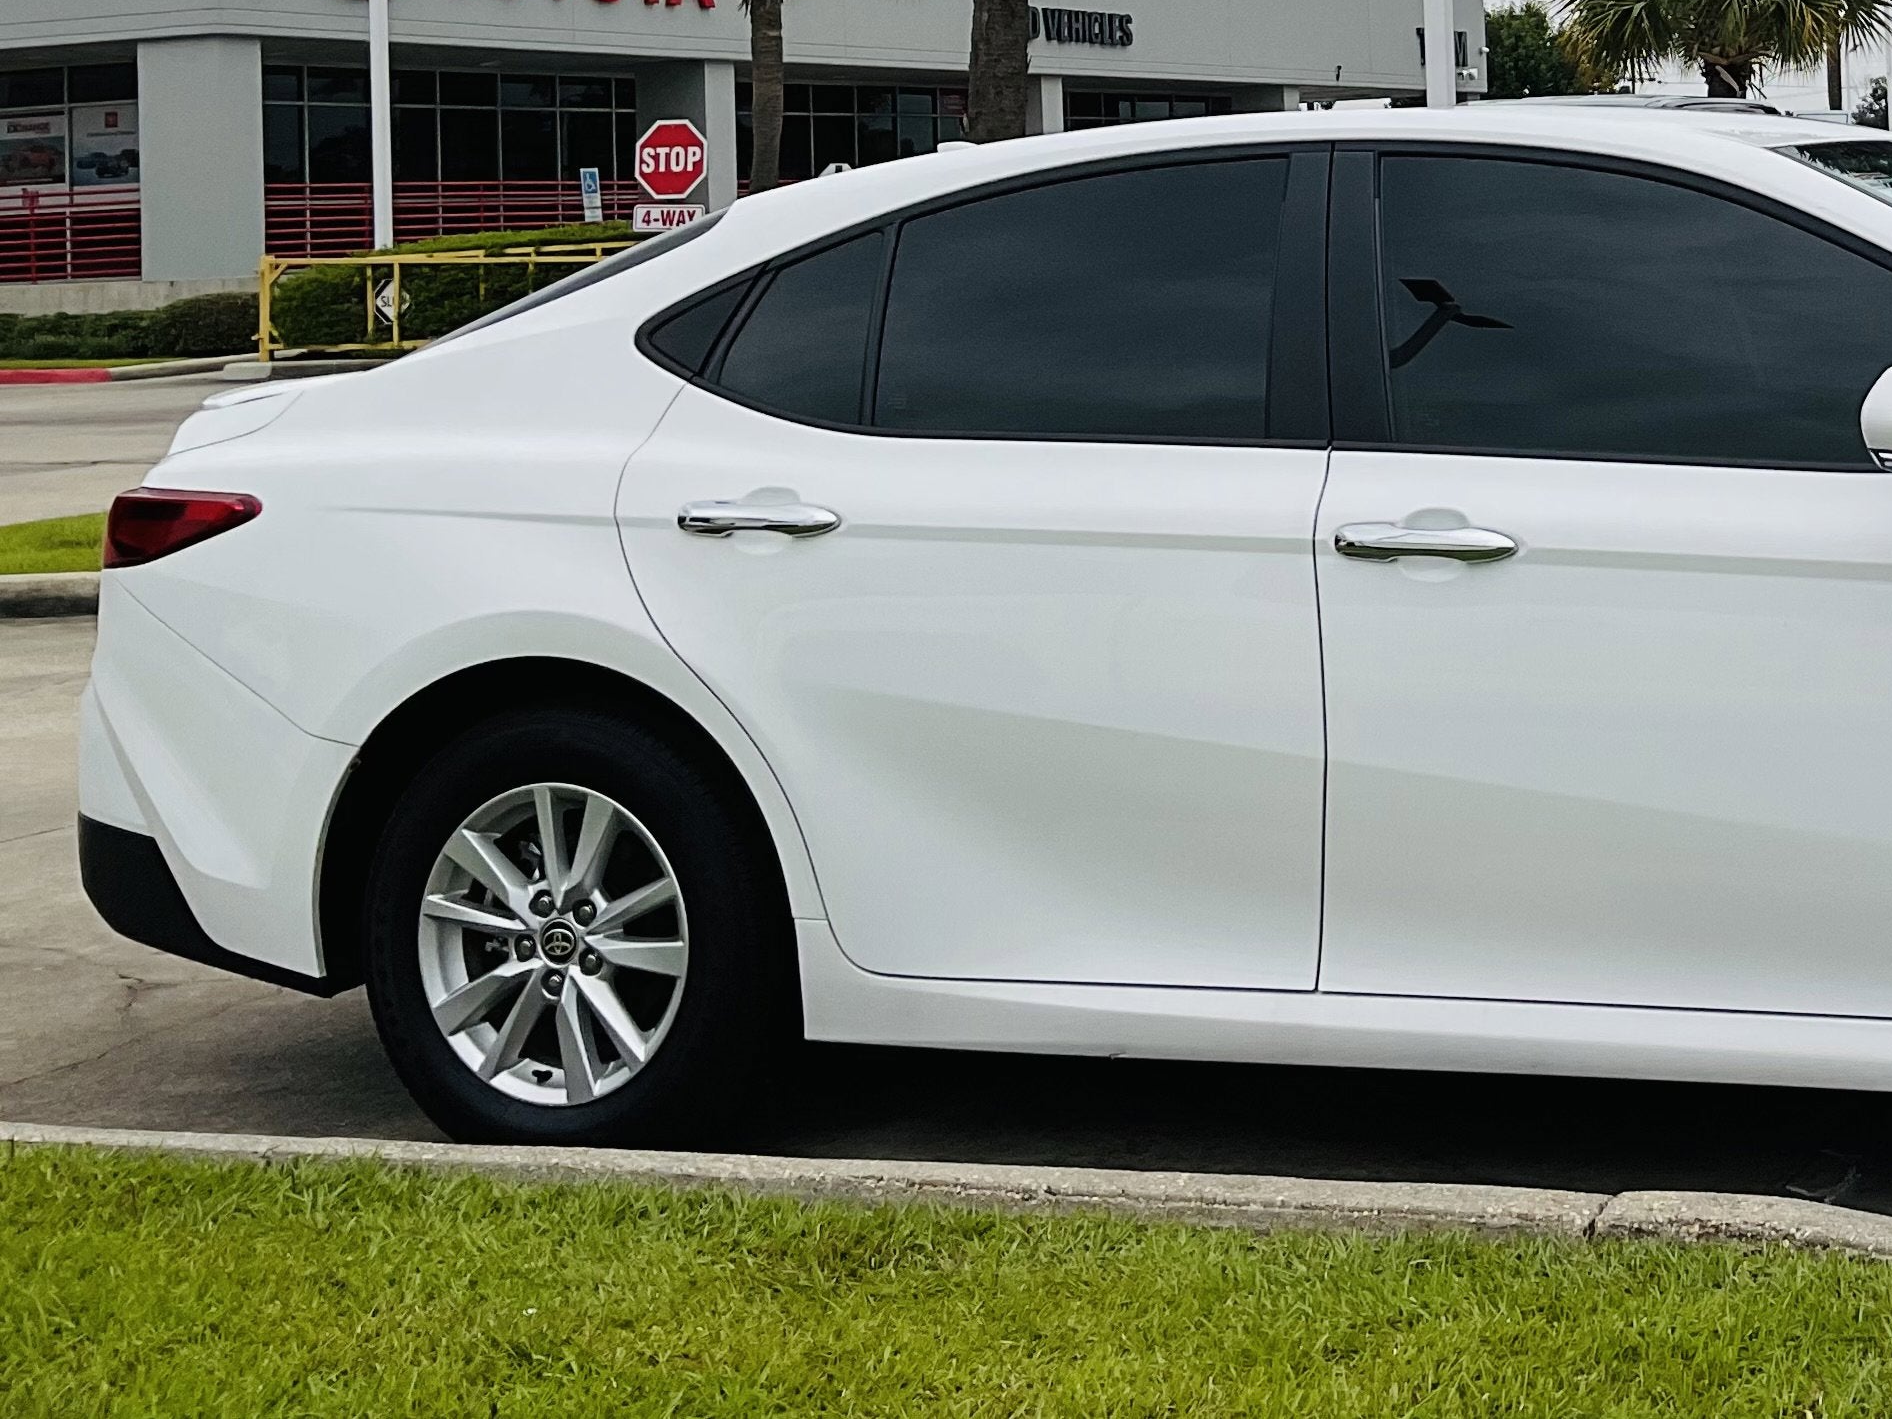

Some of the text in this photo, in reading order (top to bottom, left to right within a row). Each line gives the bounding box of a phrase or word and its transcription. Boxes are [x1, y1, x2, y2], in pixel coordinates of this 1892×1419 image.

[1041, 7, 1133, 46] VEHICLES
[641, 146, 701, 174] STOP
[641, 210, 696, 227] 4-WAY
